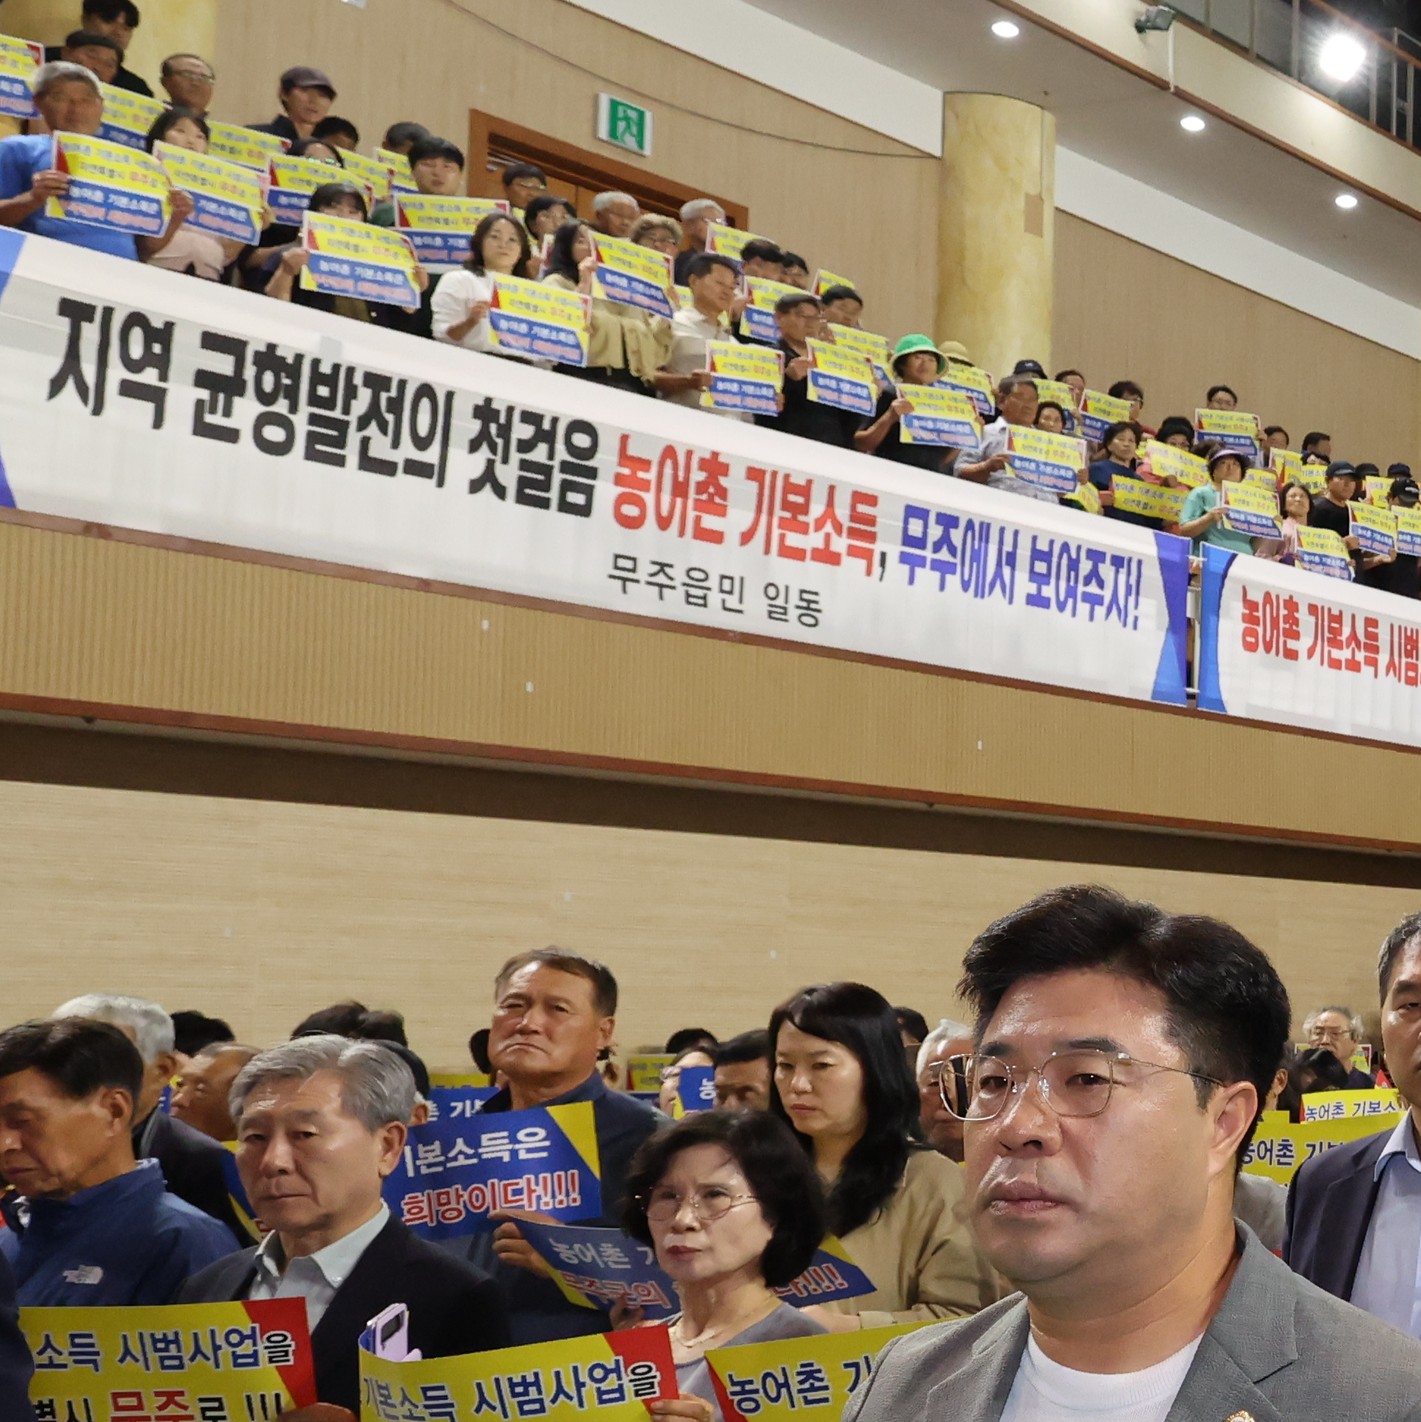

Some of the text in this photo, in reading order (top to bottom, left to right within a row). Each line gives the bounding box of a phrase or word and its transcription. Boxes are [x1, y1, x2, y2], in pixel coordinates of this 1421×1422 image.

[48, 296, 1144, 631] 지역 균형발전의 첫걸음 농어촌 기본소득, 무주에서 보여주자!
[608, 553, 823, 628] 무주읍민 일동
[1241, 585, 1299, 661] 농어촌
[1307, 602, 1379, 678] 기본소득
[402, 1169, 582, 1227] 희망이다!!!
[551, 1236, 631, 1269] 농어촌
[118, 1324, 296, 1372] 시범사업을
[472, 1358, 662, 1421] 시범사업을
[727, 1361, 832, 1416] 농어촌
